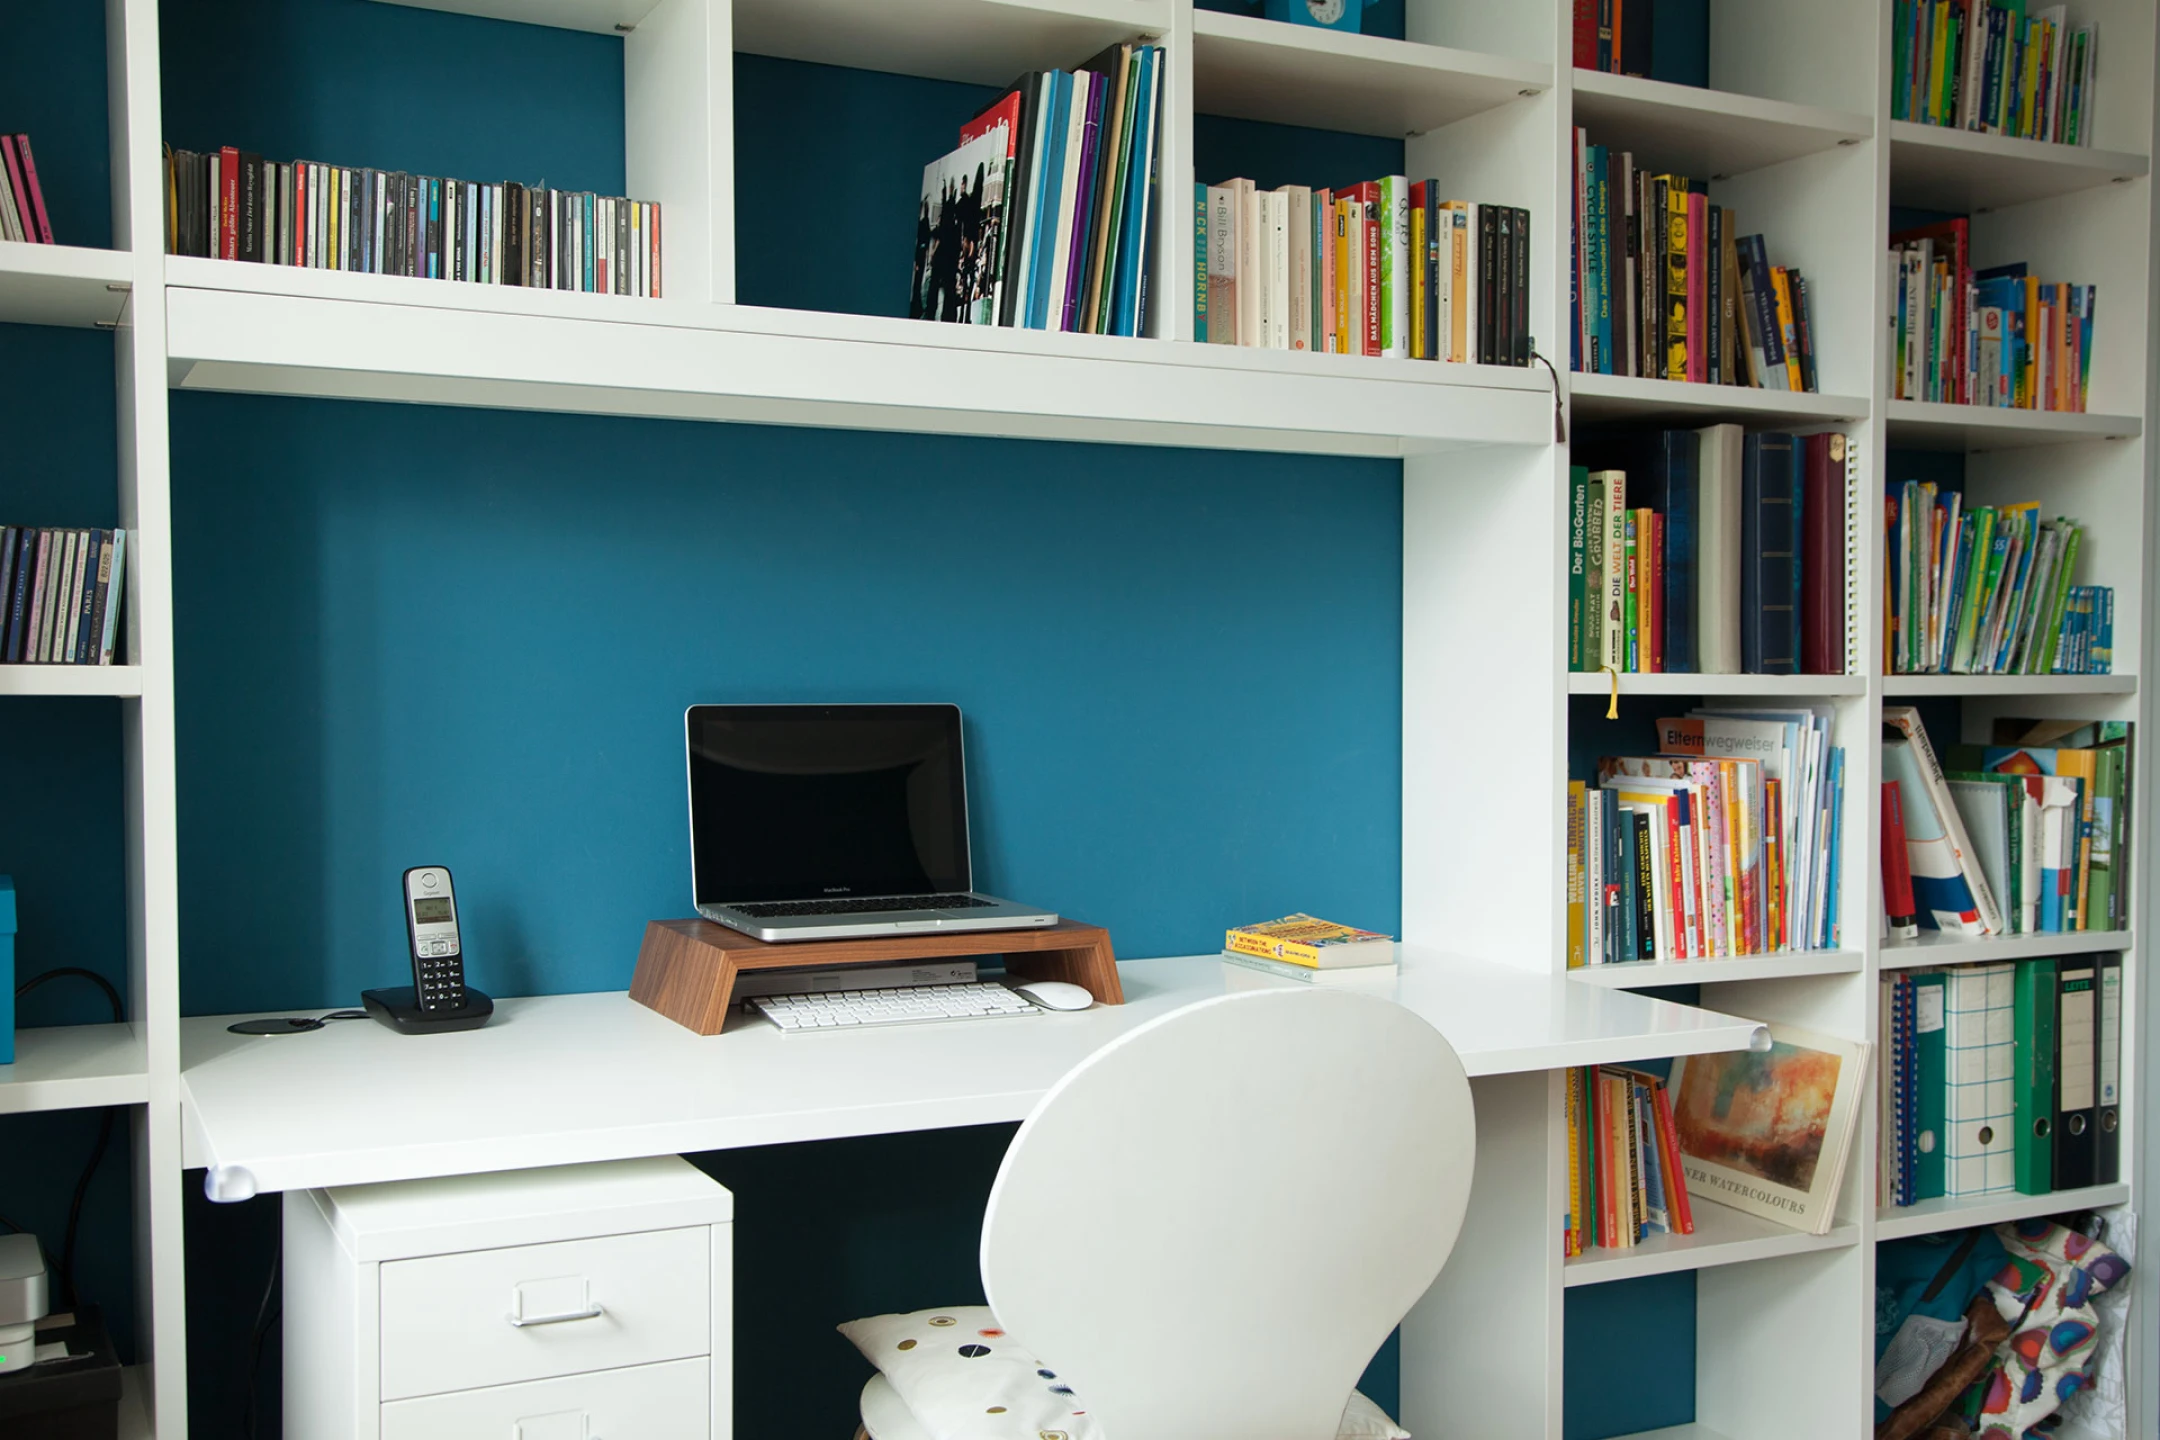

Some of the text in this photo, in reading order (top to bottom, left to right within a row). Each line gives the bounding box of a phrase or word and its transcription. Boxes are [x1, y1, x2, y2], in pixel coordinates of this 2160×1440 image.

[1214, 206, 1228, 271] Bill Bryson
[1587, 185, 1597, 274] CYCLE STYLE
[1598, 180, 1609, 318] Das Jahrhundert des Design
[1196, 201, 1207, 322] NICK HORNBY
[1368, 226, 1378, 341] DAS MÄDCHEN AUS DEM SONG
[1906, 286, 1917, 336] BERLIN
[1572, 484, 1585, 575] Der BioGarten
[1590, 498, 1603, 566] GRUBBER
[1611, 478, 1623, 597] DIE WELT DER TIERE
[84, 589, 93, 615] PARIS
[1572, 624, 1580, 664] Marie-Luise
[1667, 729, 1775, 753] Elternwegweiser
[1914, 724, 1944, 786] Jugendstil
[1568, 794, 1585, 866] EINFACHE GEWITTER
[1567, 853, 1577, 904] WILLIAM
[1673, 830, 1682, 883] Baby Kalender
[1239, 936, 1258, 946] BETWEEN
[1626, 1078, 1635, 1111] BAND
[1628, 1112, 1637, 1150] ERSTER
[1630, 1157, 1638, 1187] LEBEN
[1684, 1167, 1806, 1216] NER WATERCOLOURS
[1633, 1207, 1641, 1237] MUSIK
